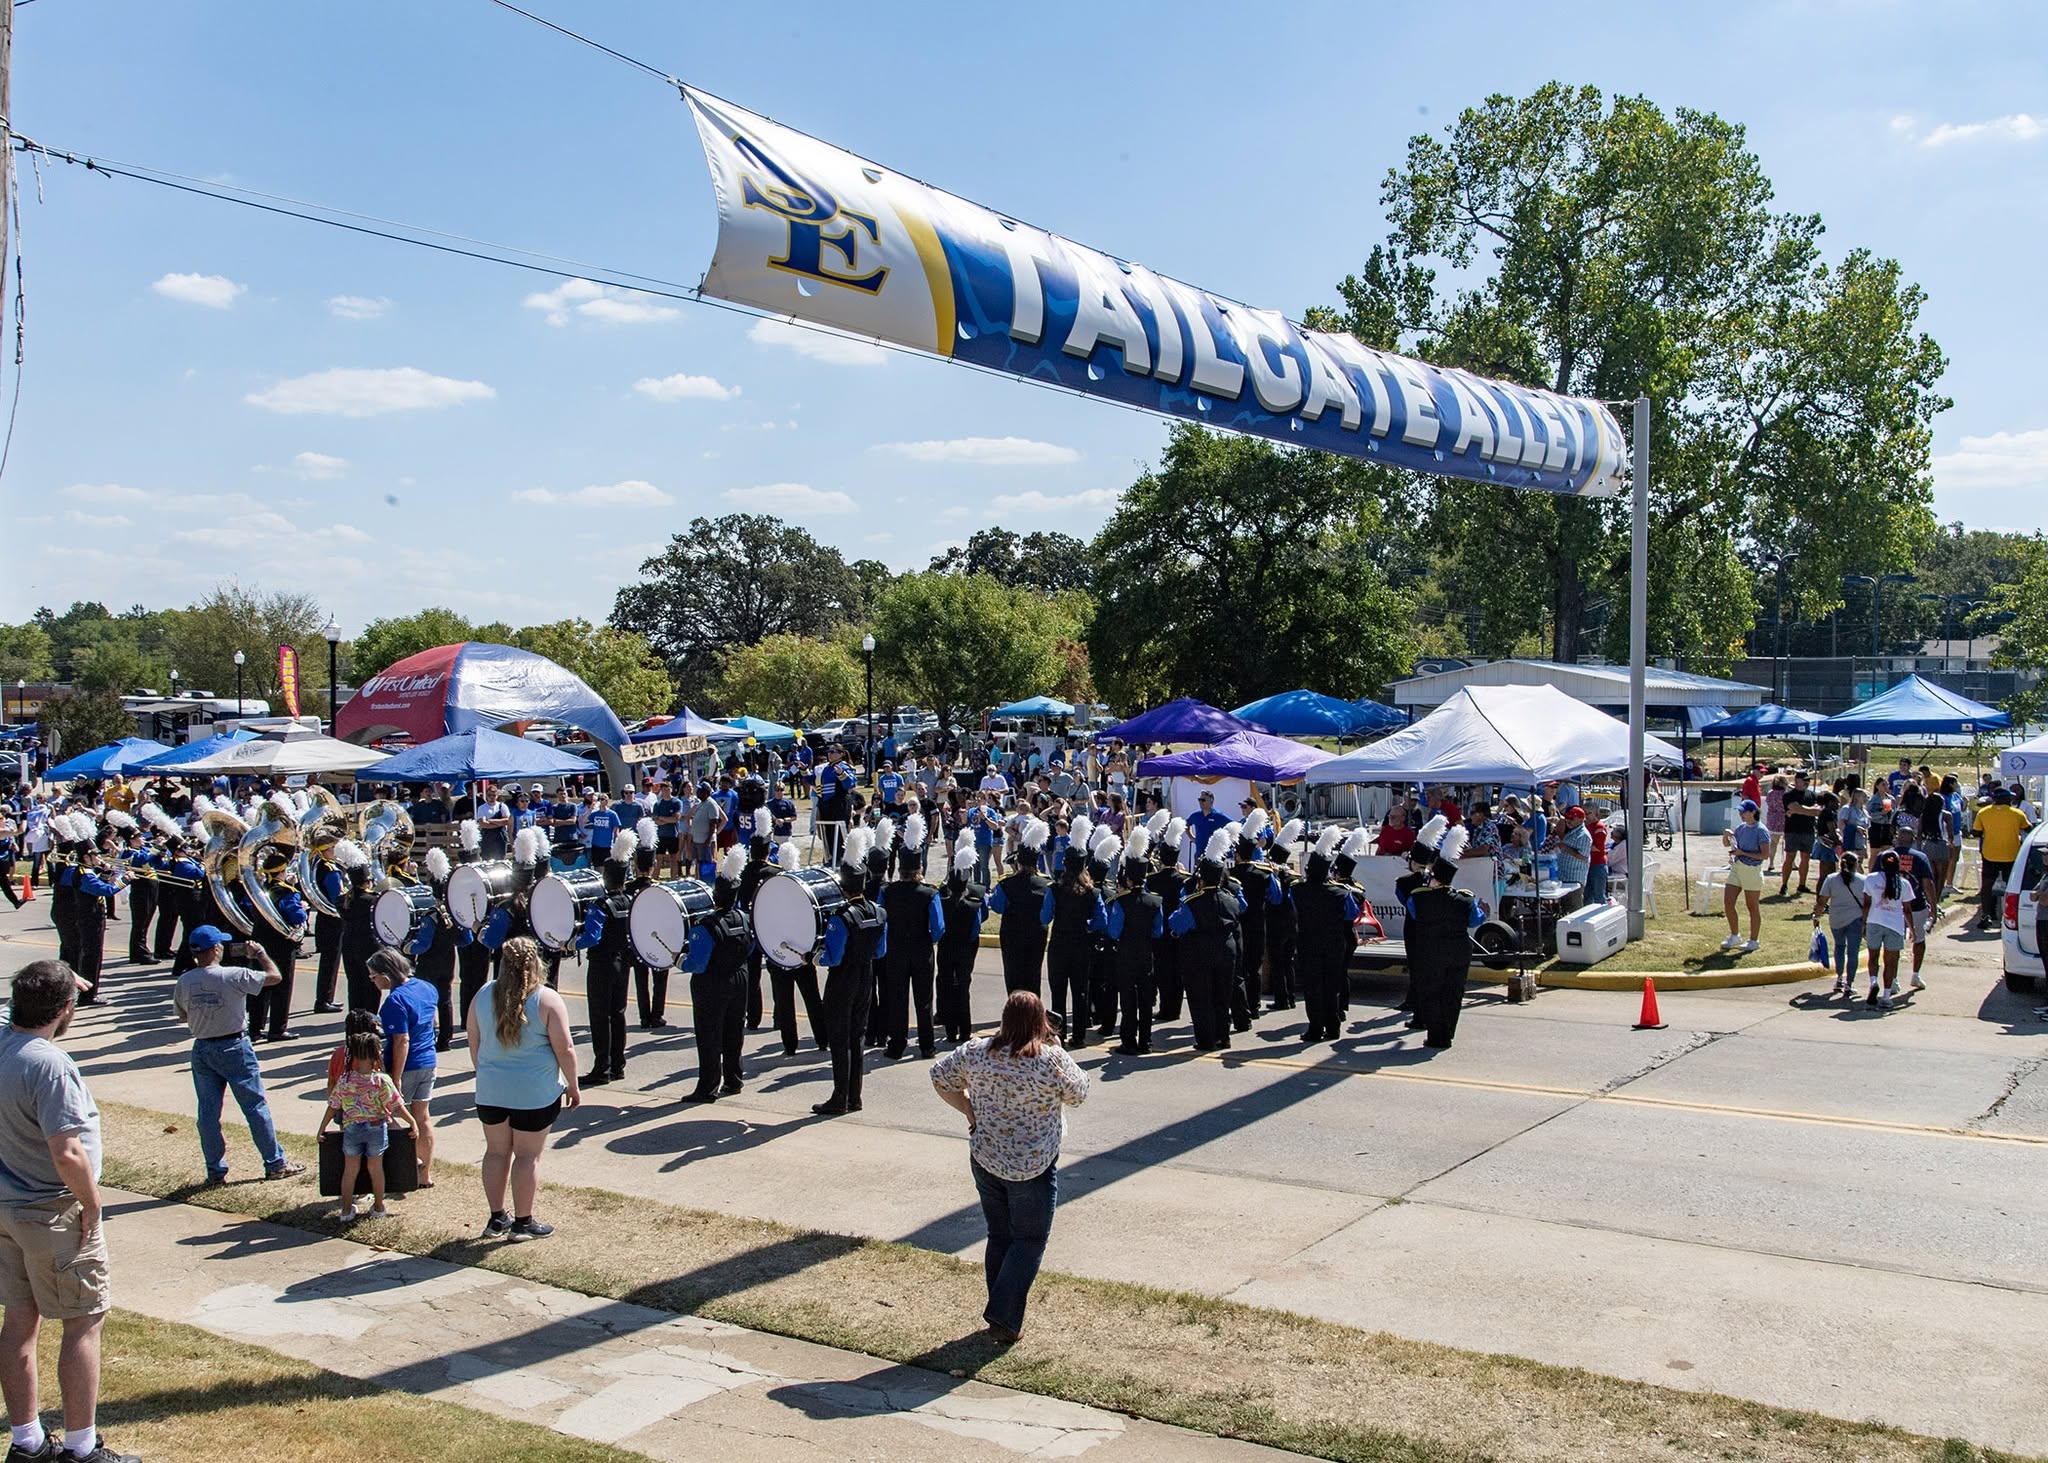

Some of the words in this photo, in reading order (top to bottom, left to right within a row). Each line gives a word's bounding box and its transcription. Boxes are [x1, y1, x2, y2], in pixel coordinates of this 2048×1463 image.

[983, 222, 1441, 449] TAILGATE
[1450, 368, 1586, 476] ALLEY
[634, 744, 655, 759] SIG
[738, 815, 752, 830] 95
